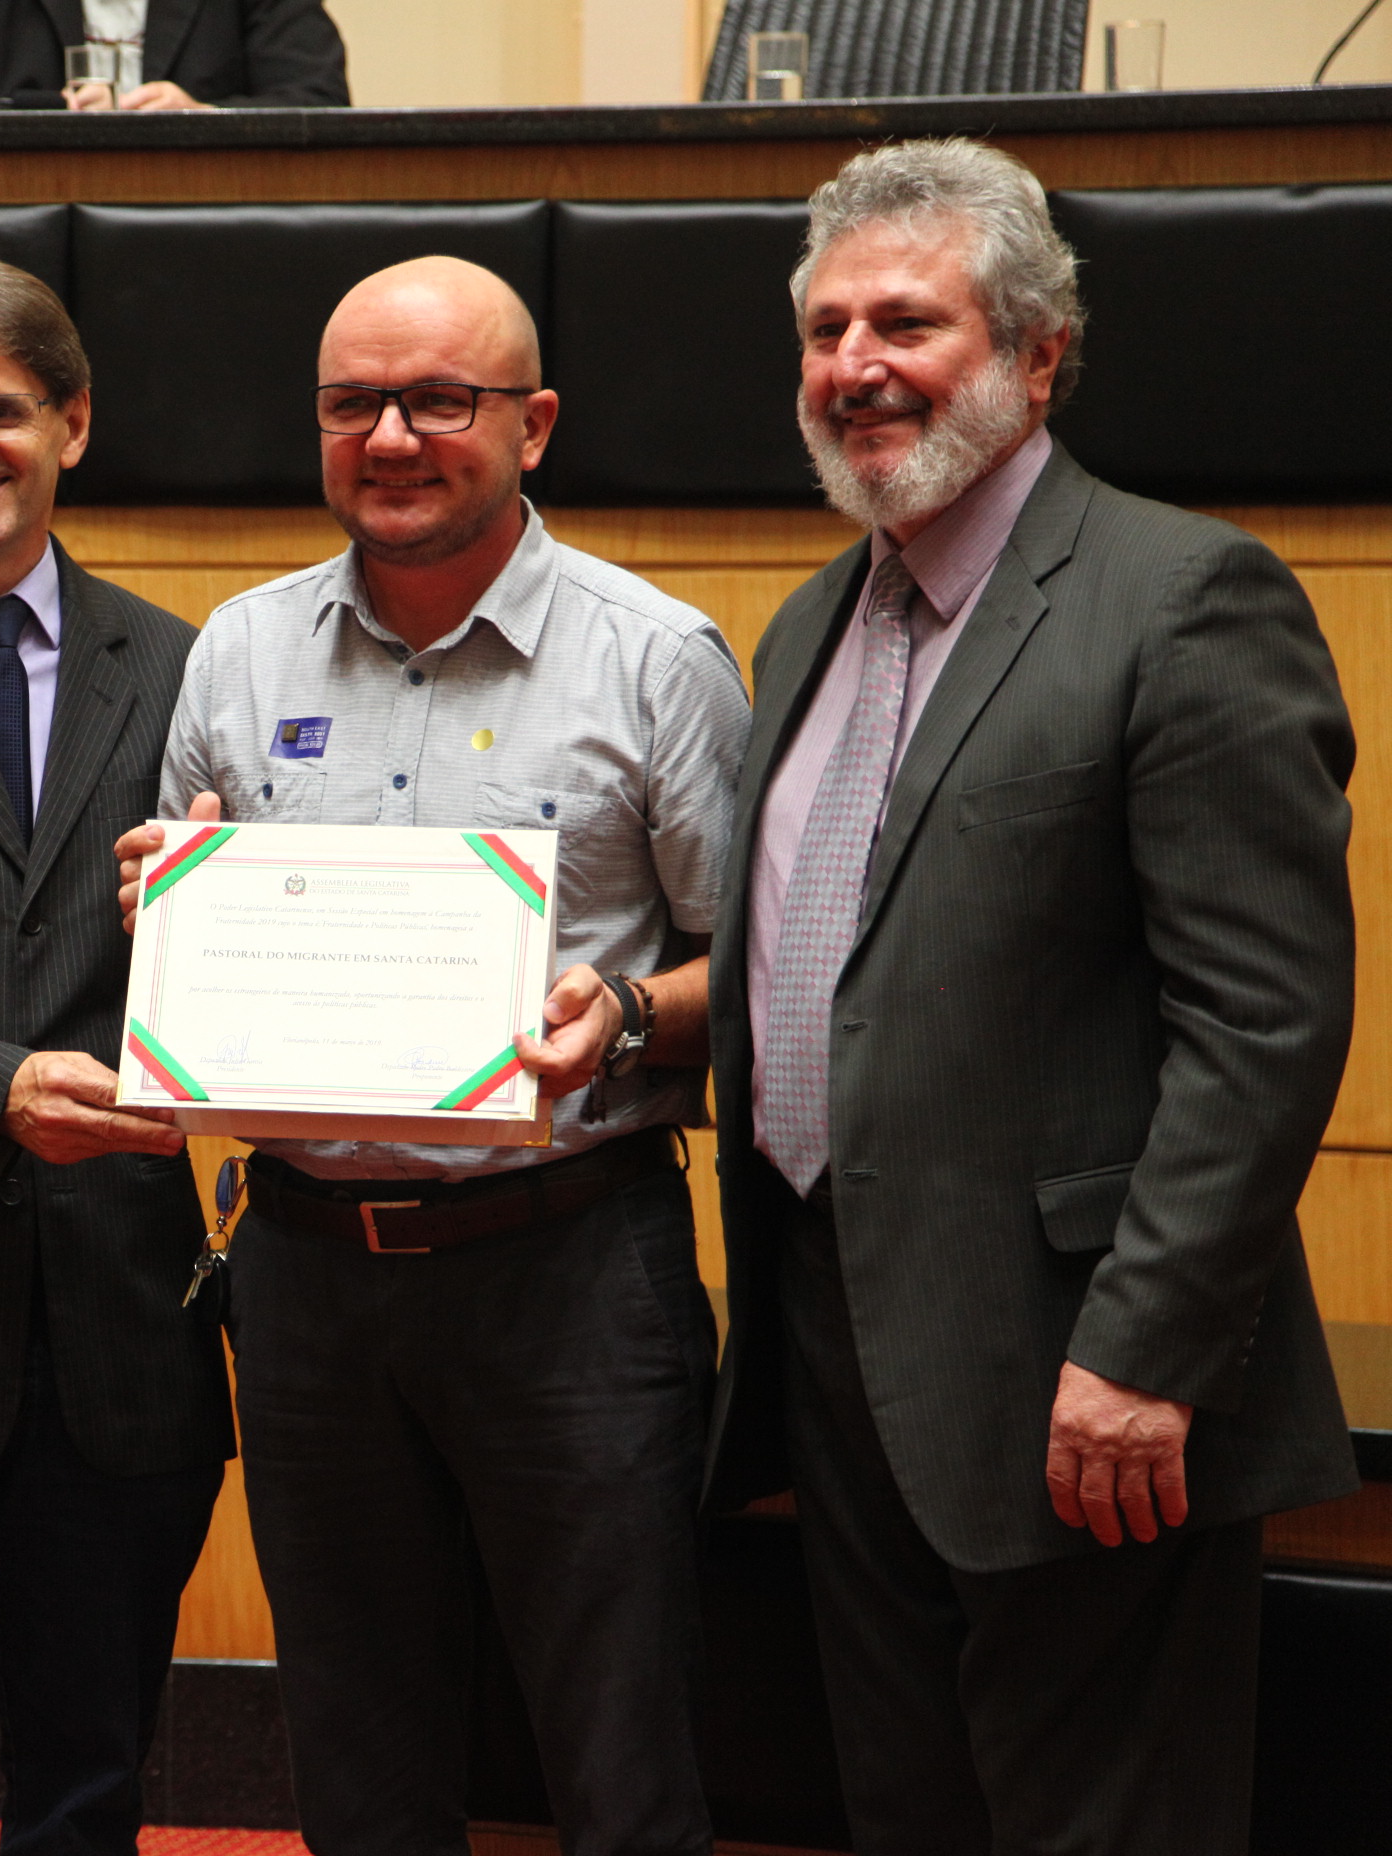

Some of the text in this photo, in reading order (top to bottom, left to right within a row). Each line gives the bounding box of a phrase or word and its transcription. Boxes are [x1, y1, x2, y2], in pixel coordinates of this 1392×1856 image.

[203, 949, 478, 966] PASTORAL DO MIGRANTE EM SANTA CATARINA
